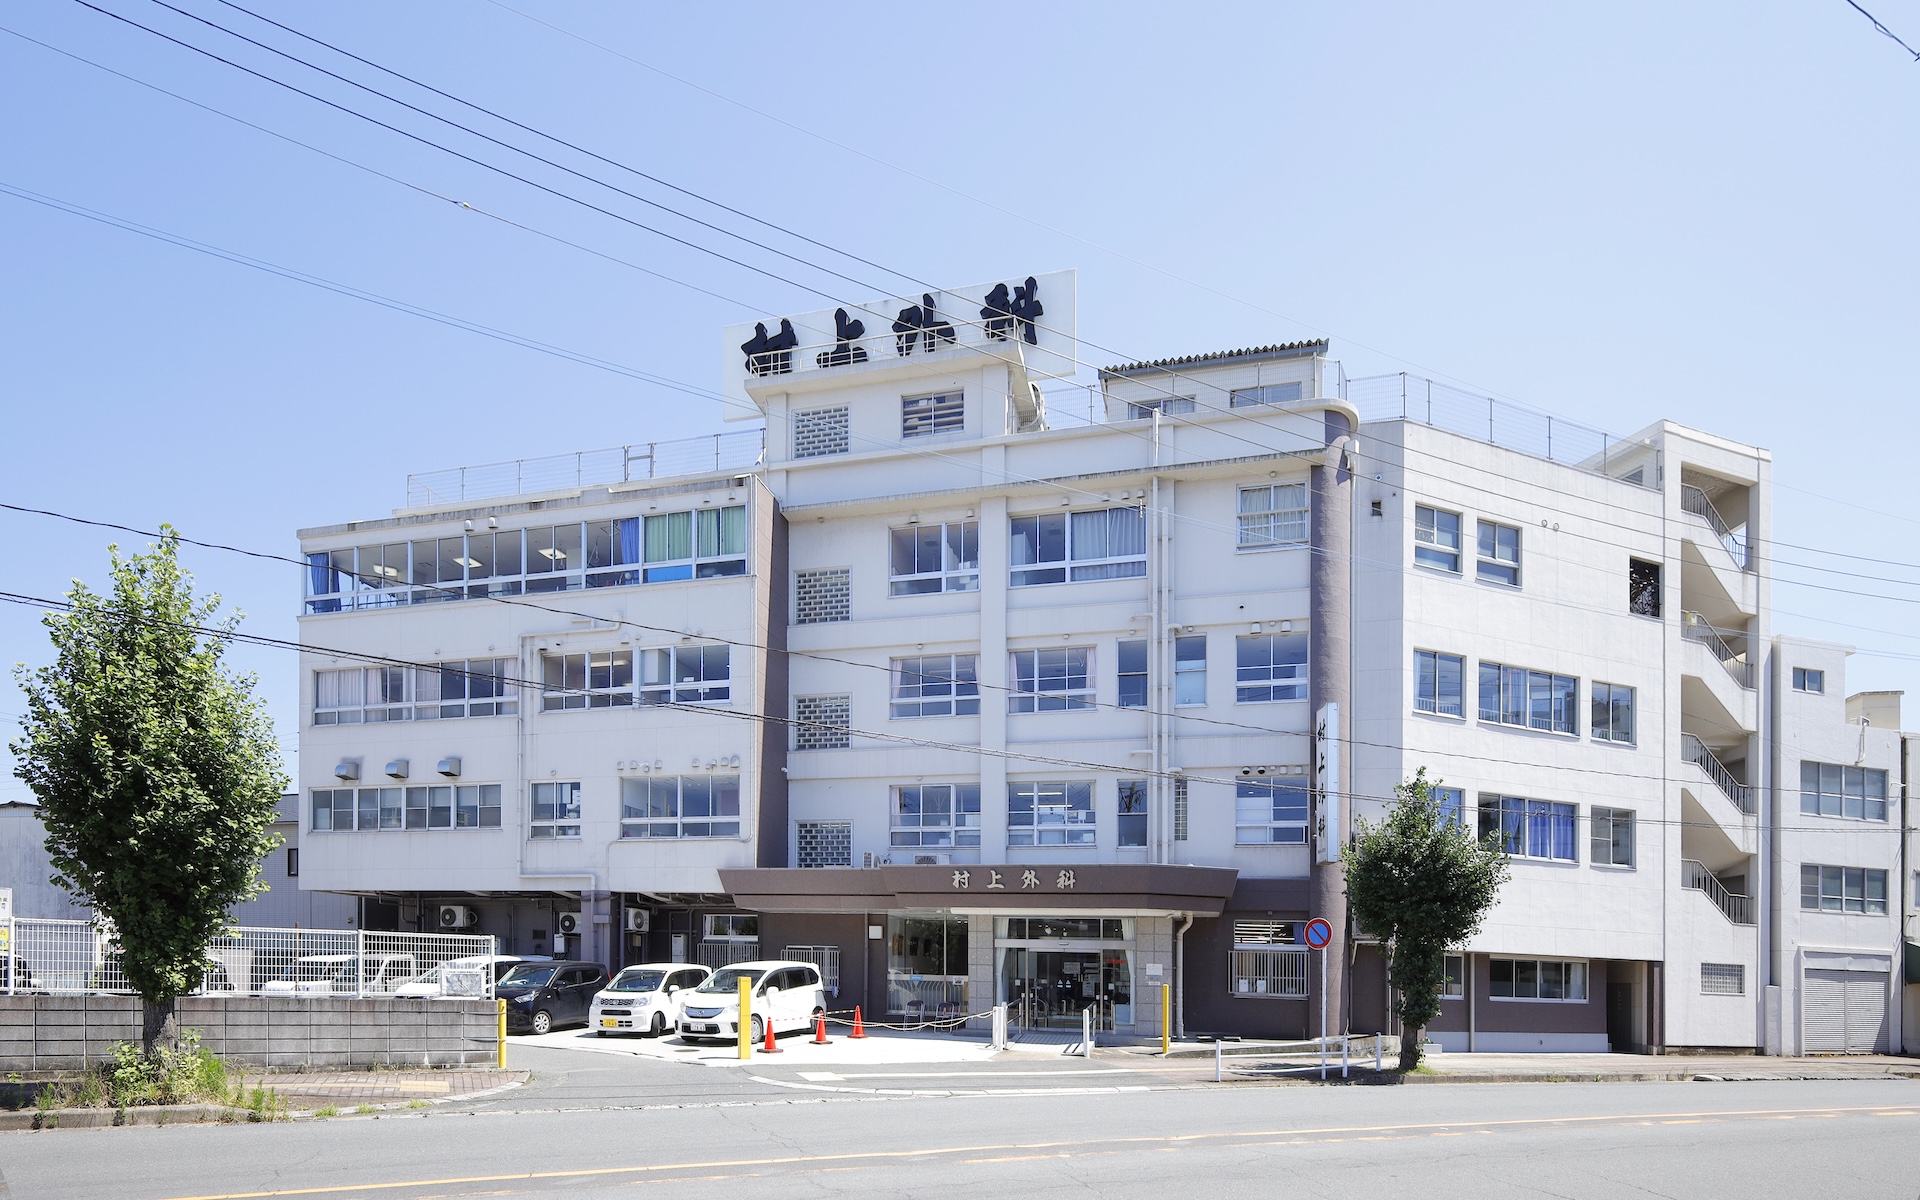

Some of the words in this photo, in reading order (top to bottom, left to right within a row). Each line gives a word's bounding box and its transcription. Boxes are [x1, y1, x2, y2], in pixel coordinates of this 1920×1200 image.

[741, 276, 1044, 377] 村上外科
[951, 869, 1076, 889] 村上外科
